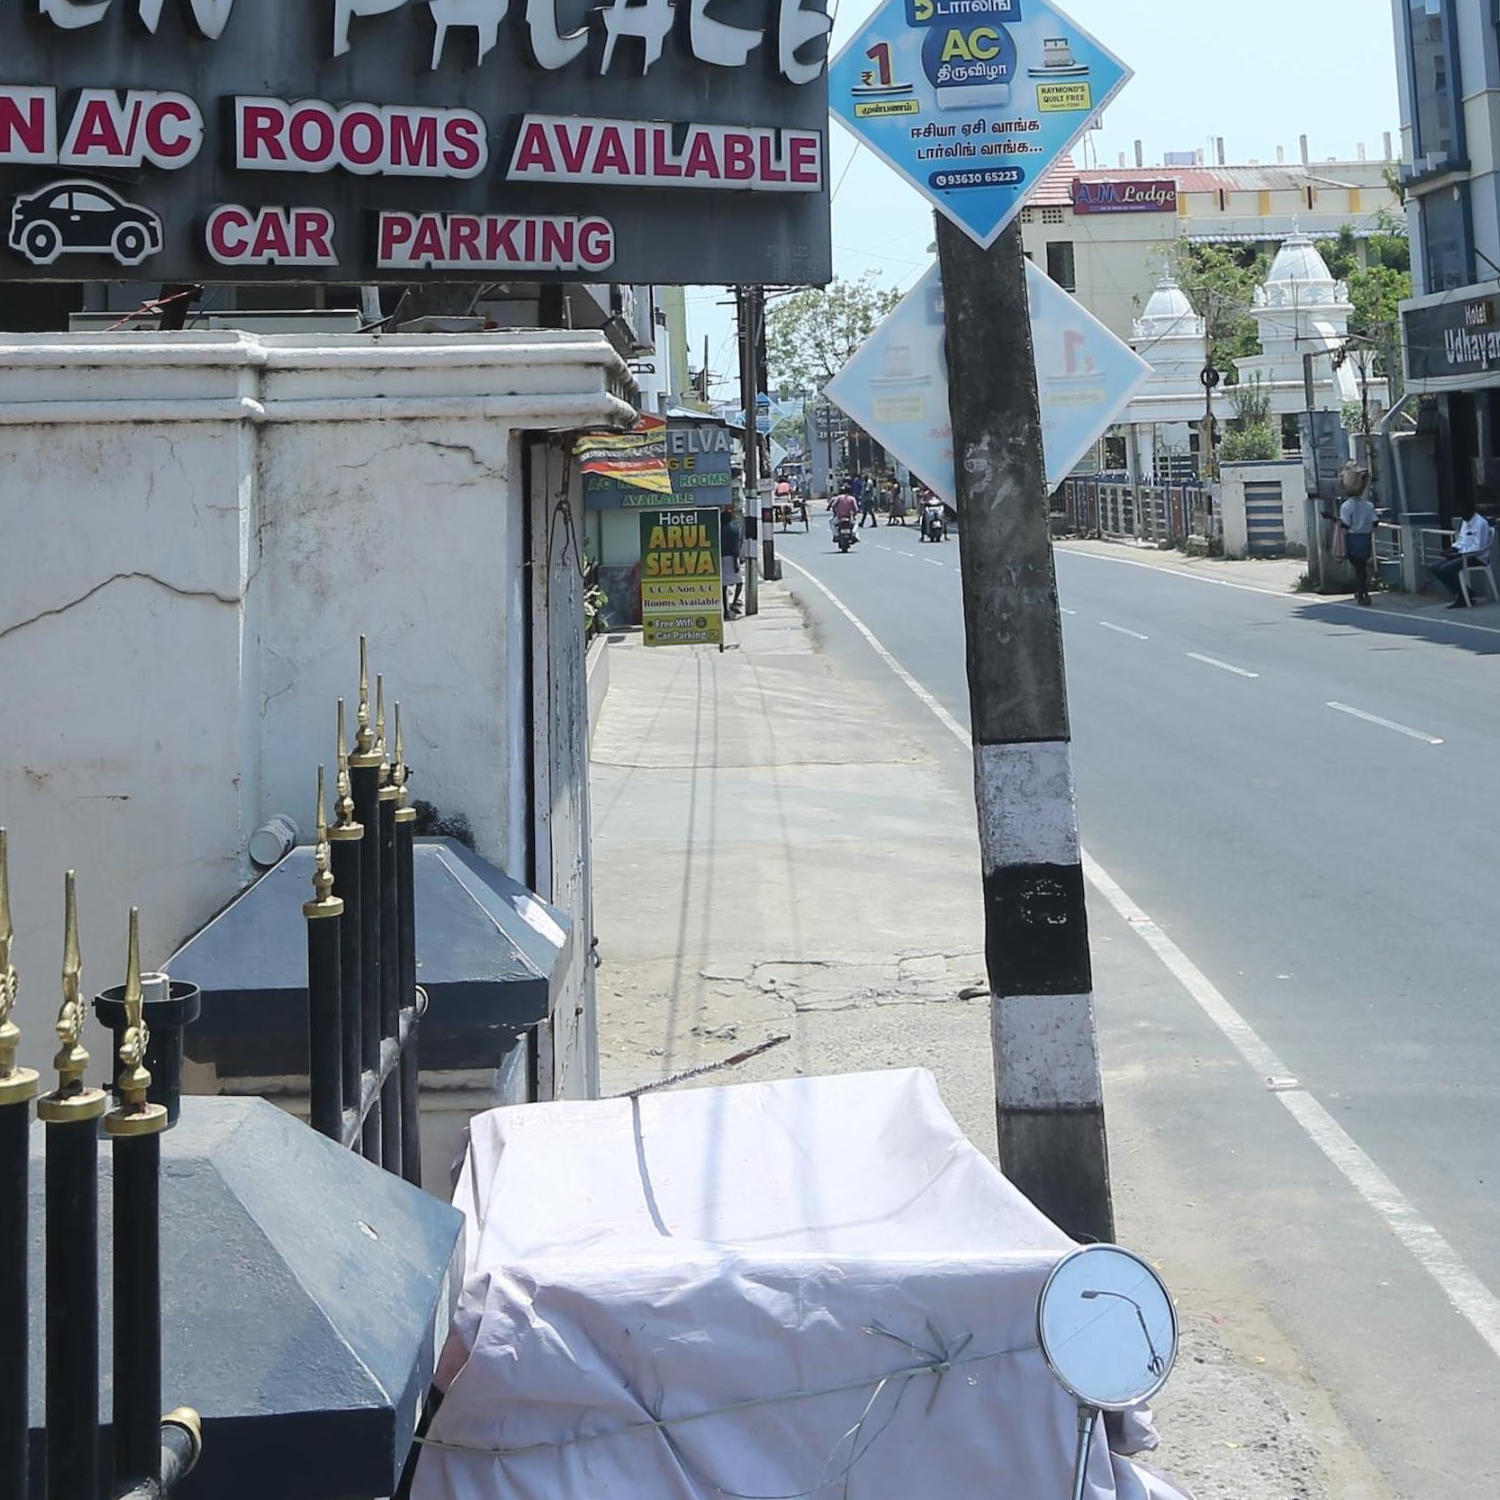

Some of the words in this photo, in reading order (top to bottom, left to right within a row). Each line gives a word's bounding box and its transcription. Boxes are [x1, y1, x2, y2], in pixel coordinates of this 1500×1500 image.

[941, 27, 1000, 62] AC
[937, 62, 1007, 83] திருவிழா
[64, 88, 198, 163] A/C
[240, 101, 485, 174] ROOMS
[510, 116, 821, 187] AVAILABLE
[911, 122, 956, 138] ஈசியா
[961, 118, 986, 137] ஏசி
[991, 117, 1040, 133] வாங்க
[917, 141, 976, 160] டார்லிங்
[947, 174, 982, 185] 93630
[984, 170, 1018, 182] 65223
[1122, 184, 1175, 206] Lodge
[208, 206, 336, 262] CAR
[379, 213, 613, 267] PARKING
[1465, 302, 1486, 325] Hotel
[672, 431, 729, 454] ELVA
[680, 473, 729, 487] ROOMS
[622, 492, 694, 507] AVAILABLE
[659, 511, 698, 525] Hotel
[649, 524, 711, 549] ARUL
[645, 550, 716, 575] SELVA
[644, 599, 676, 608] Rooms
[678, 597, 719, 606] Available
[674, 630, 708, 641] Parking
